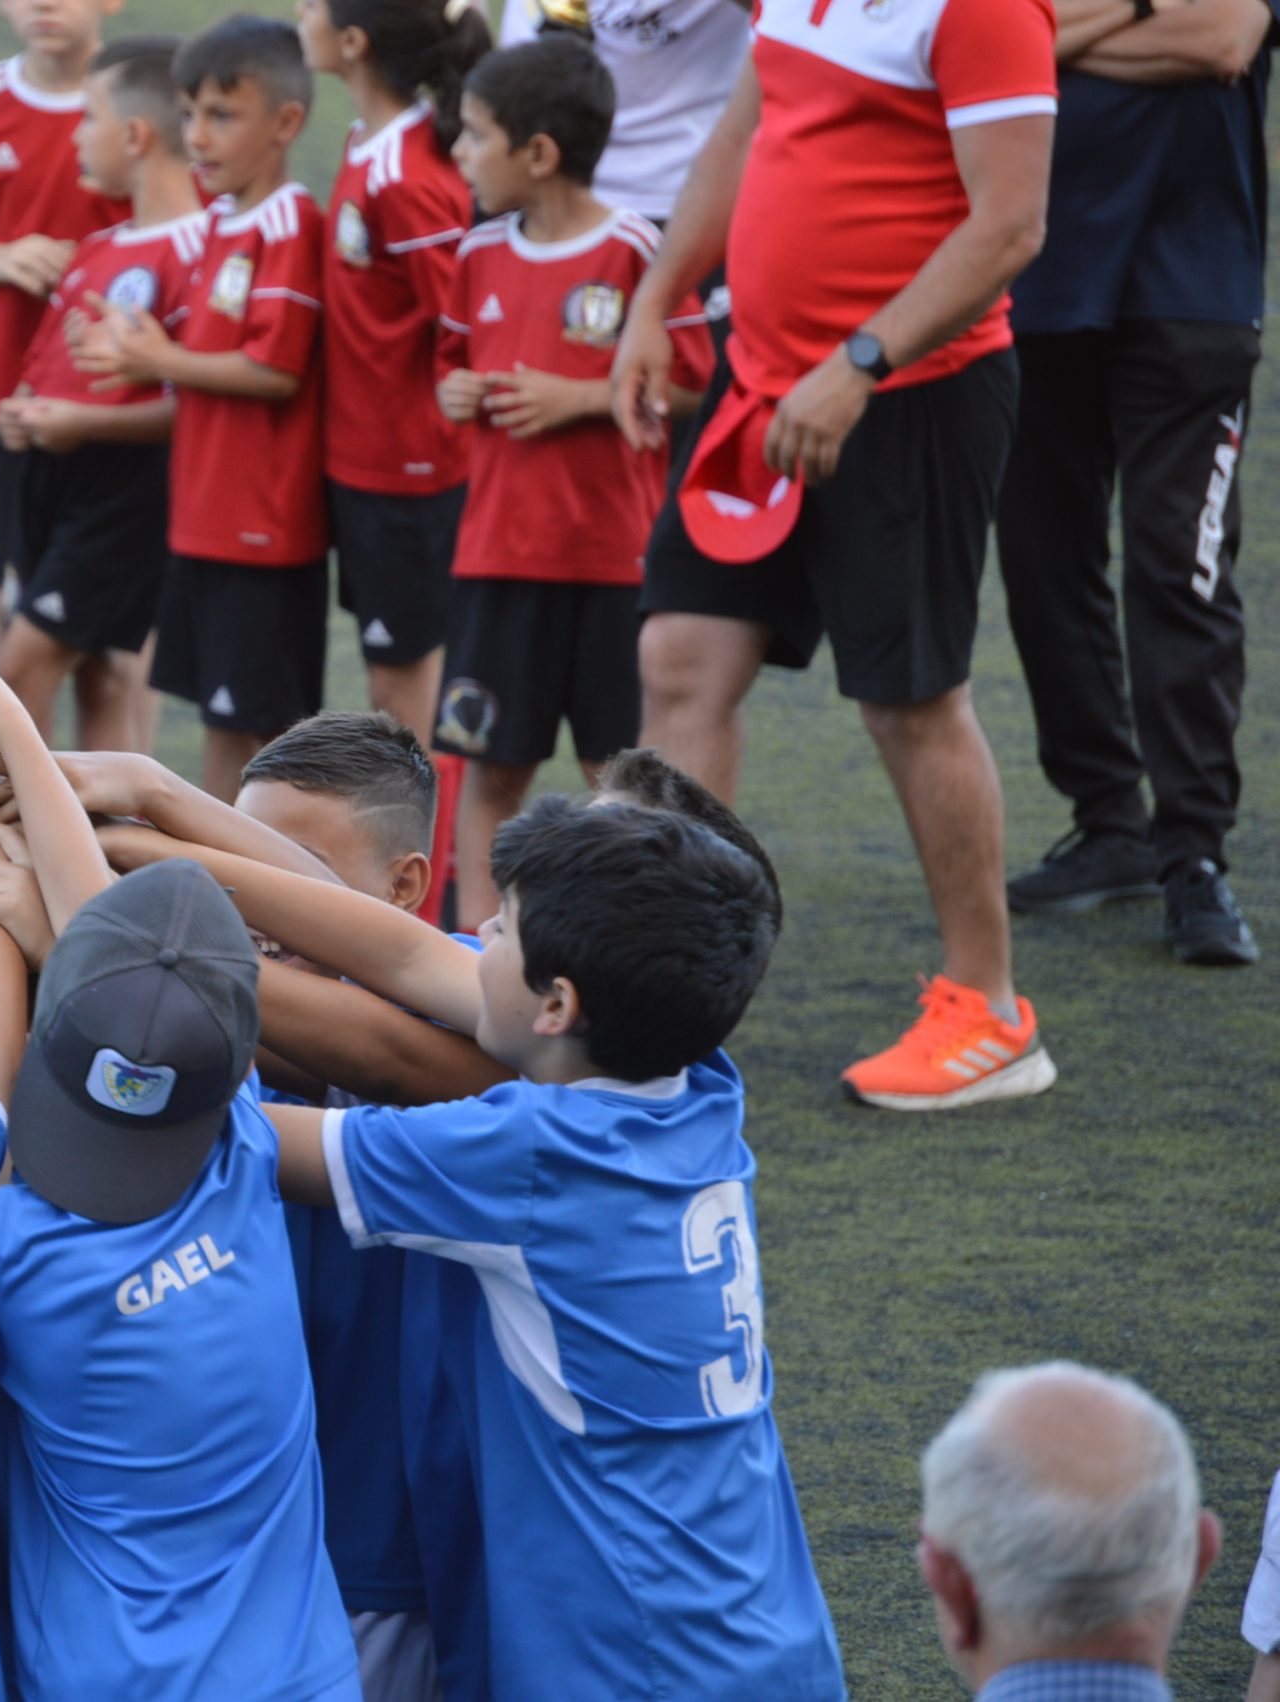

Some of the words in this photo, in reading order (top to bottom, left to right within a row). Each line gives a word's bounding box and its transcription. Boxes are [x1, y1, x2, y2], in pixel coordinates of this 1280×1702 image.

[1191, 443, 1239, 602] LEGEA
[116, 1233, 236, 1316] GAEL
[681, 1180, 764, 1418] 3
